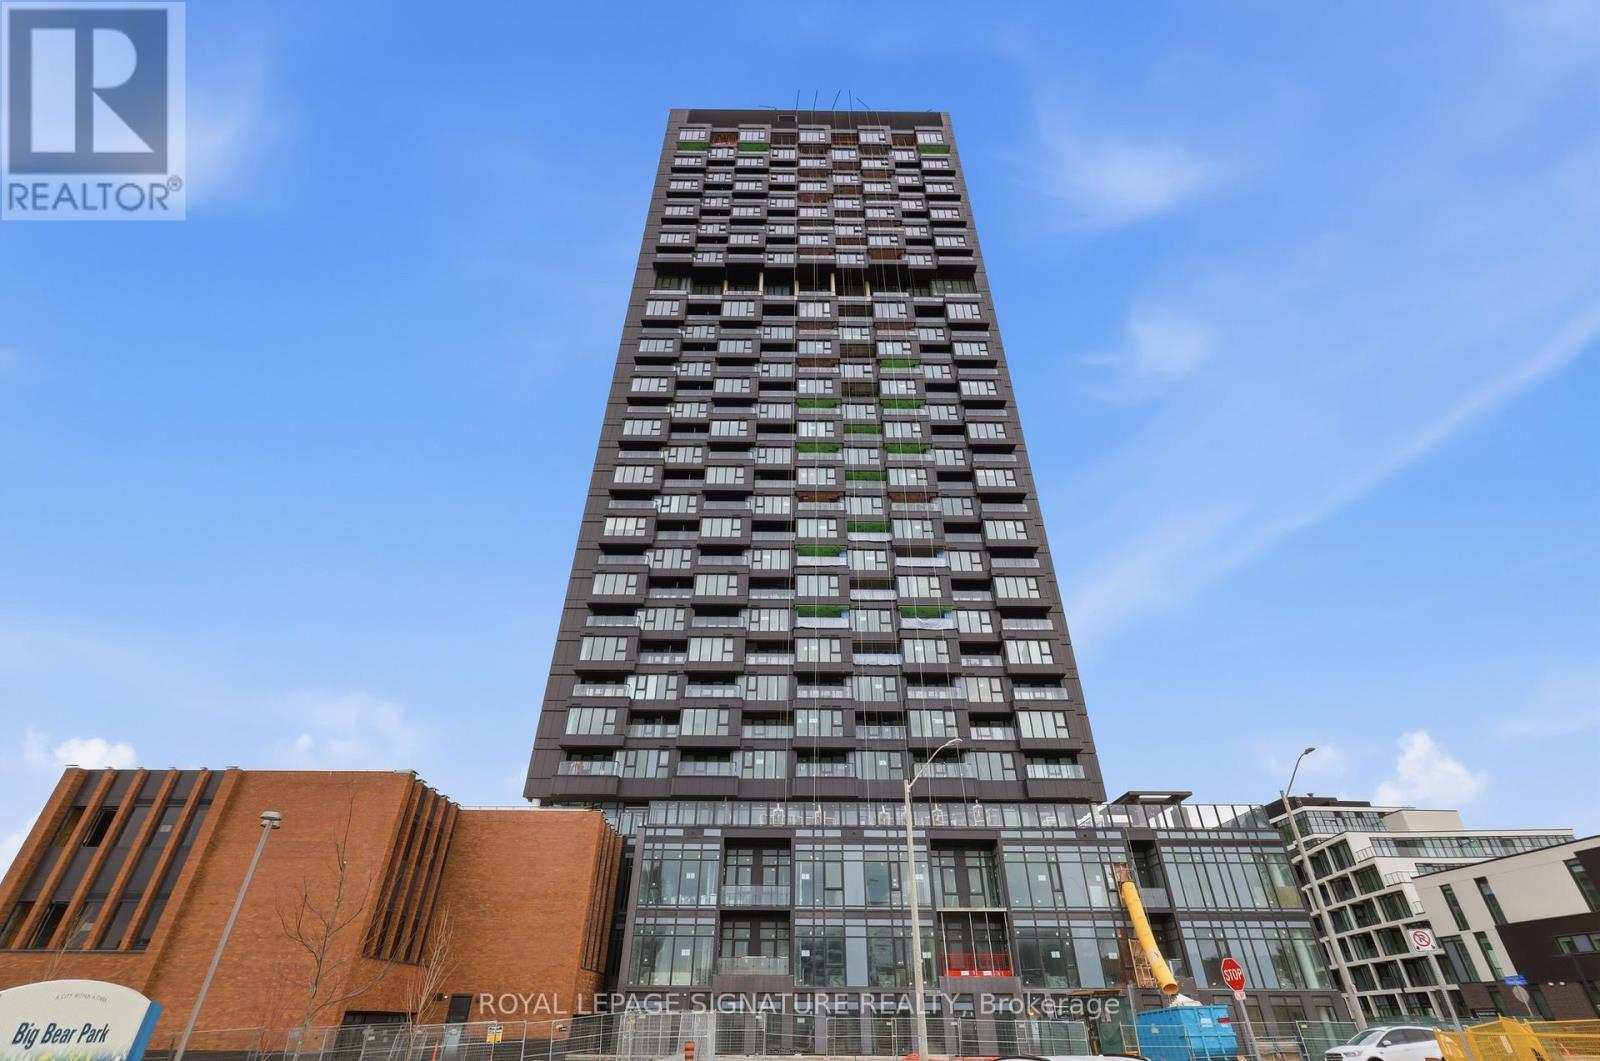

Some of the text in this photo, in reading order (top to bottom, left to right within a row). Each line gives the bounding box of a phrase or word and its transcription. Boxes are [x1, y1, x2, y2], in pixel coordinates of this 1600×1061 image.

[1224, 968, 1242, 981] STOP
[11, 1022, 110, 1050] Big Bear Park
